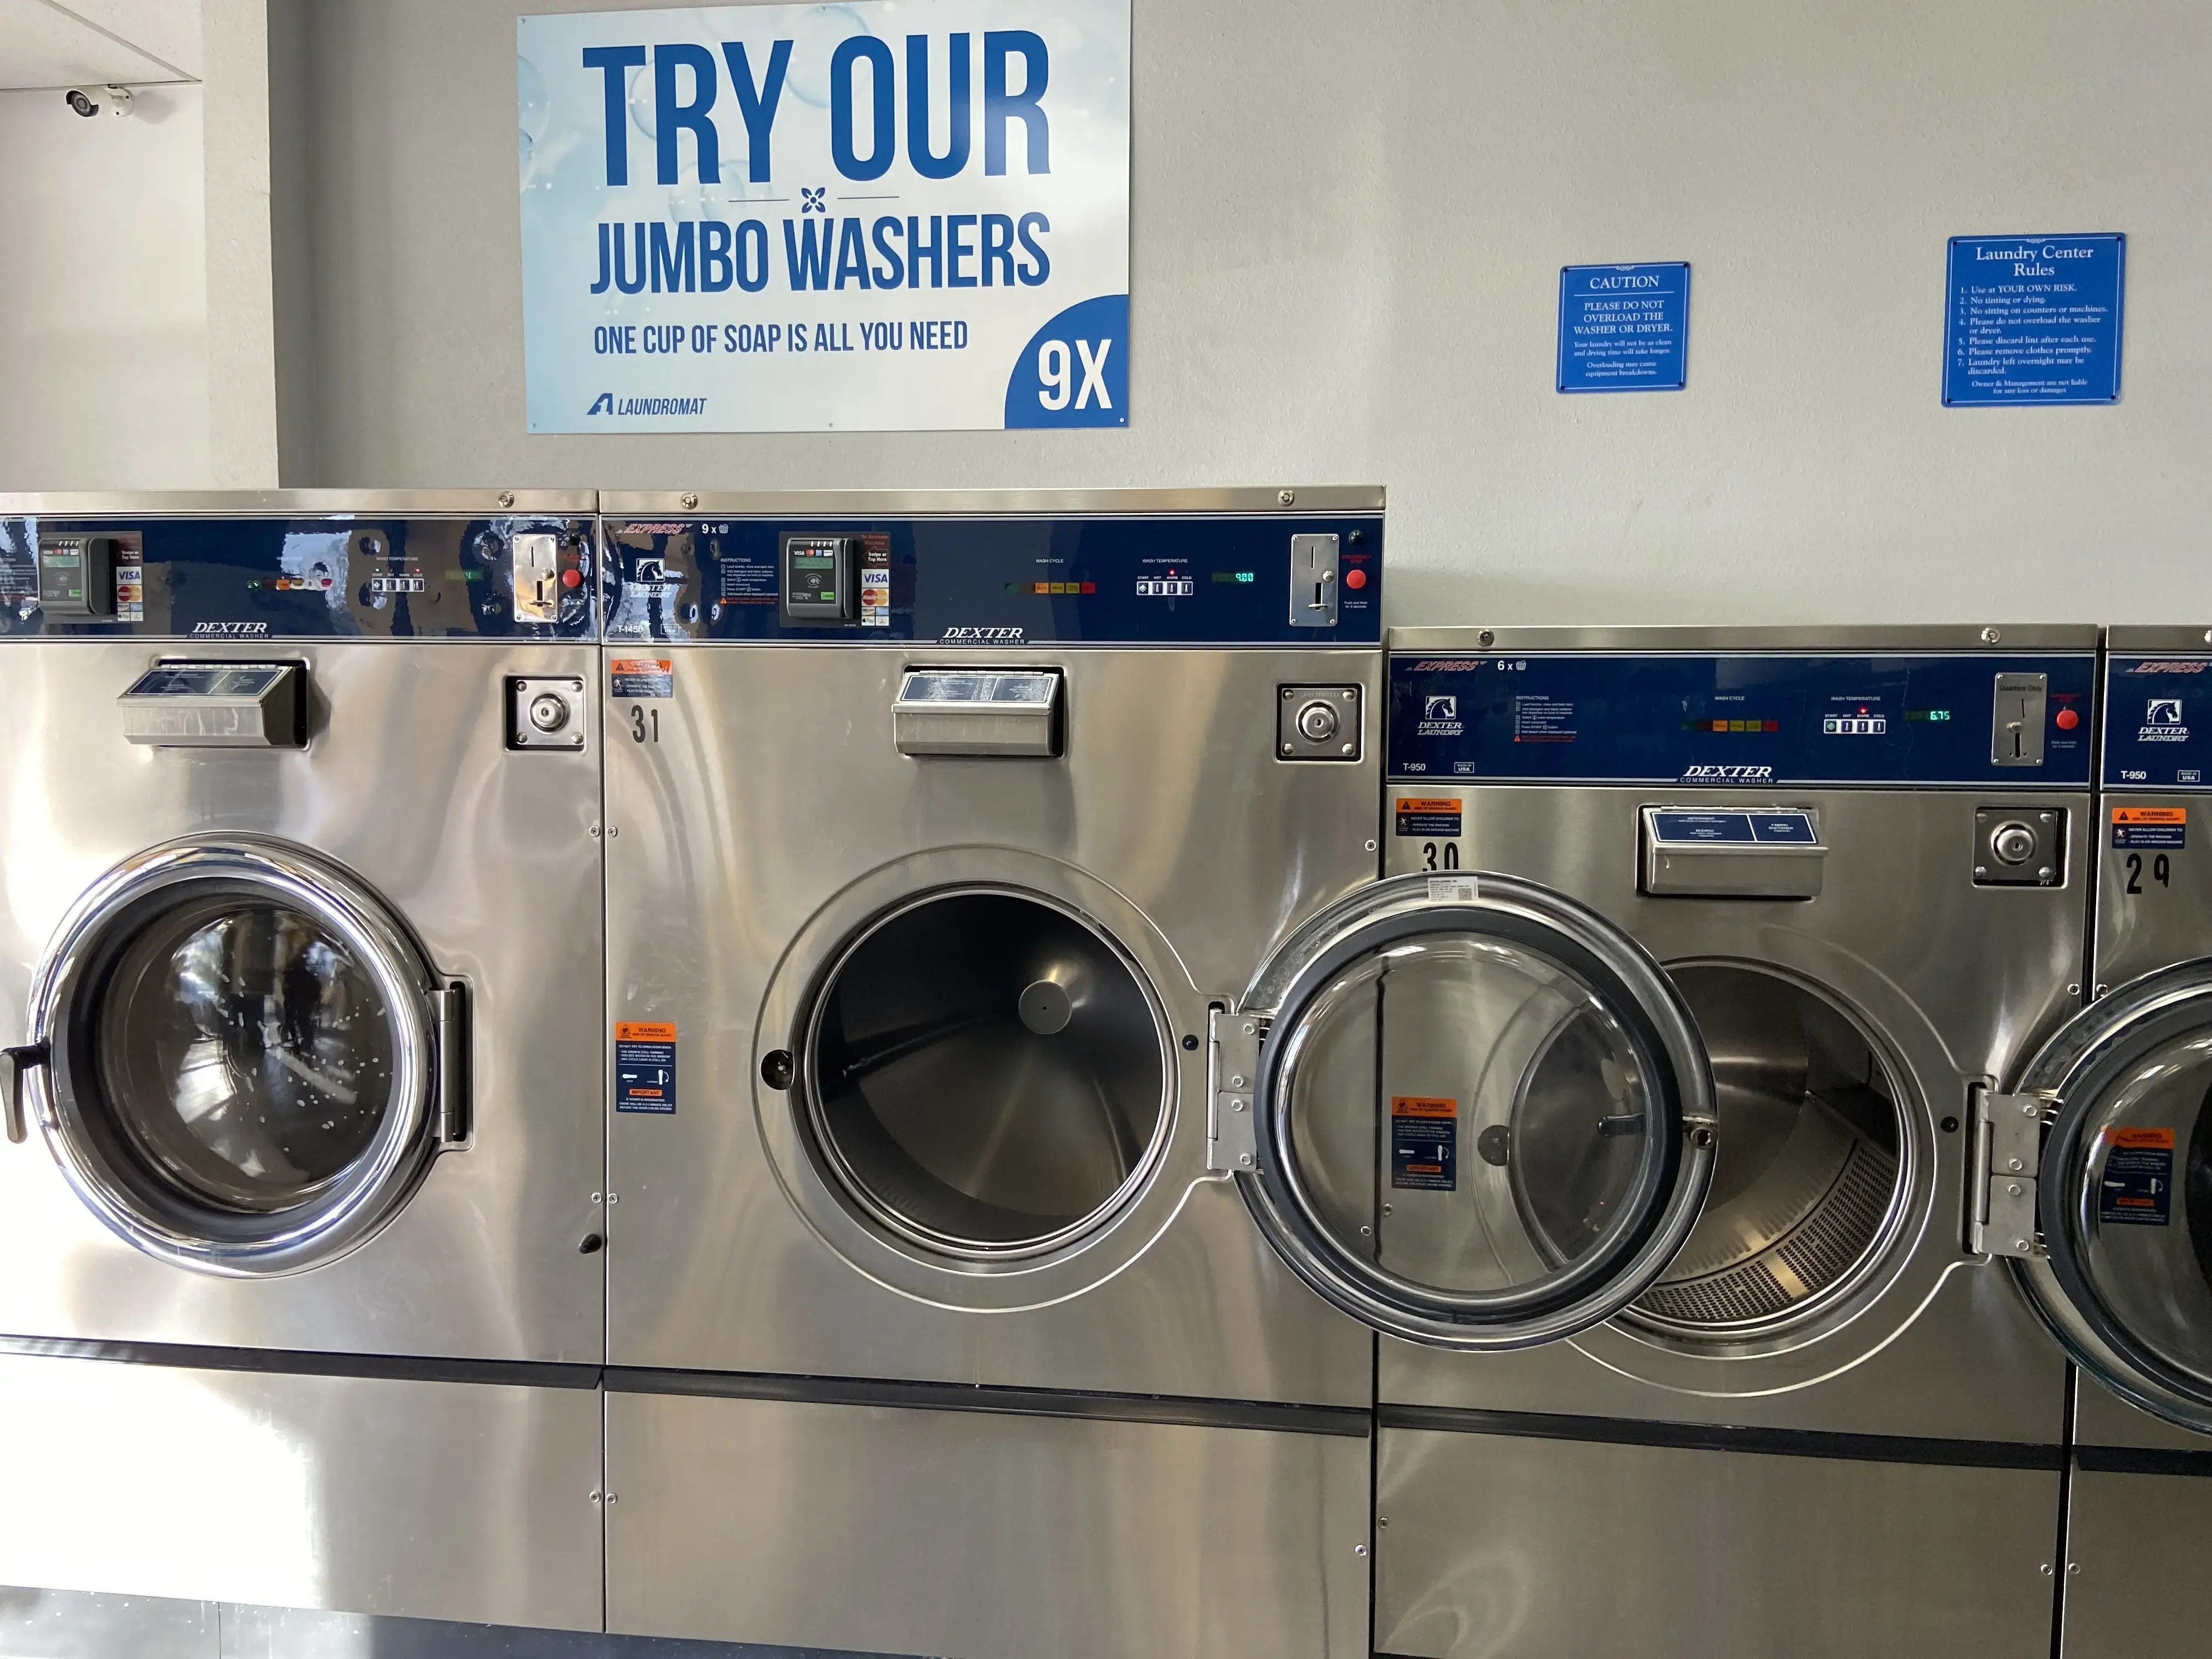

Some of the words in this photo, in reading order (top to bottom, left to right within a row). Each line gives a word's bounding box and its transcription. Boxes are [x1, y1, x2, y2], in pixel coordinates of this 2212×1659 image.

[582, 40, 794, 187] TRY
[830, 30, 1051, 182] OUR
[590, 219, 769, 295] JUMBO
[785, 211, 1051, 292] WASHERS
[1976, 246, 2038, 262] Laundry
[2042, 245, 2094, 259] Center
[2014, 263, 2055, 276] Rules
[1590, 275, 1659, 289] CAUTION
[1584, 302, 1620, 311] PLEASE
[1623, 301, 1638, 309] DO
[1641, 301, 1664, 309] NOT
[1985, 307, 2008, 315] sitting
[1584, 313, 1640, 323] OVERLOAD
[1643, 312, 1663, 320] THE
[1574, 325, 1616, 335] WASHER
[1619, 325, 1634, 333] OR
[1637, 324, 1673, 332] DRYER.
[594, 325, 636, 355] ONE
[643, 325, 685, 354] CUP
[692, 324, 718, 353] OF
[724, 324, 780, 353] SOAP
[787, 323, 806, 352] IS
[814, 323, 853, 352] ALL
[859, 322, 902, 351] YOU
[910, 321, 967, 350] NEED
[1968, 359, 2000, 368] Laundry
[2018, 358, 2054, 366] overnight
[1037, 338, 1112, 411] 9X
[617, 398, 707, 416] LAUNDROMAT
[624, 524, 685, 534] EXPRESS
[702, 524, 709, 533] 9
[119, 572, 140, 580] VISA
[864, 574, 888, 583] VISA
[193, 622, 268, 633] DEXTER
[943, 628, 1023, 639] DEXTER
[1413, 661, 1478, 670] EXPRESS
[1497, 661, 1504, 670] 6
[2135, 662, 2207, 673] EXPRESS
[631, 705, 658, 743] 31
[1683, 766, 1772, 777] DEXTER
[2121, 771, 2146, 779] T-950
[1423, 842, 1459, 872] 30
[2126, 853, 2169, 894] 29
